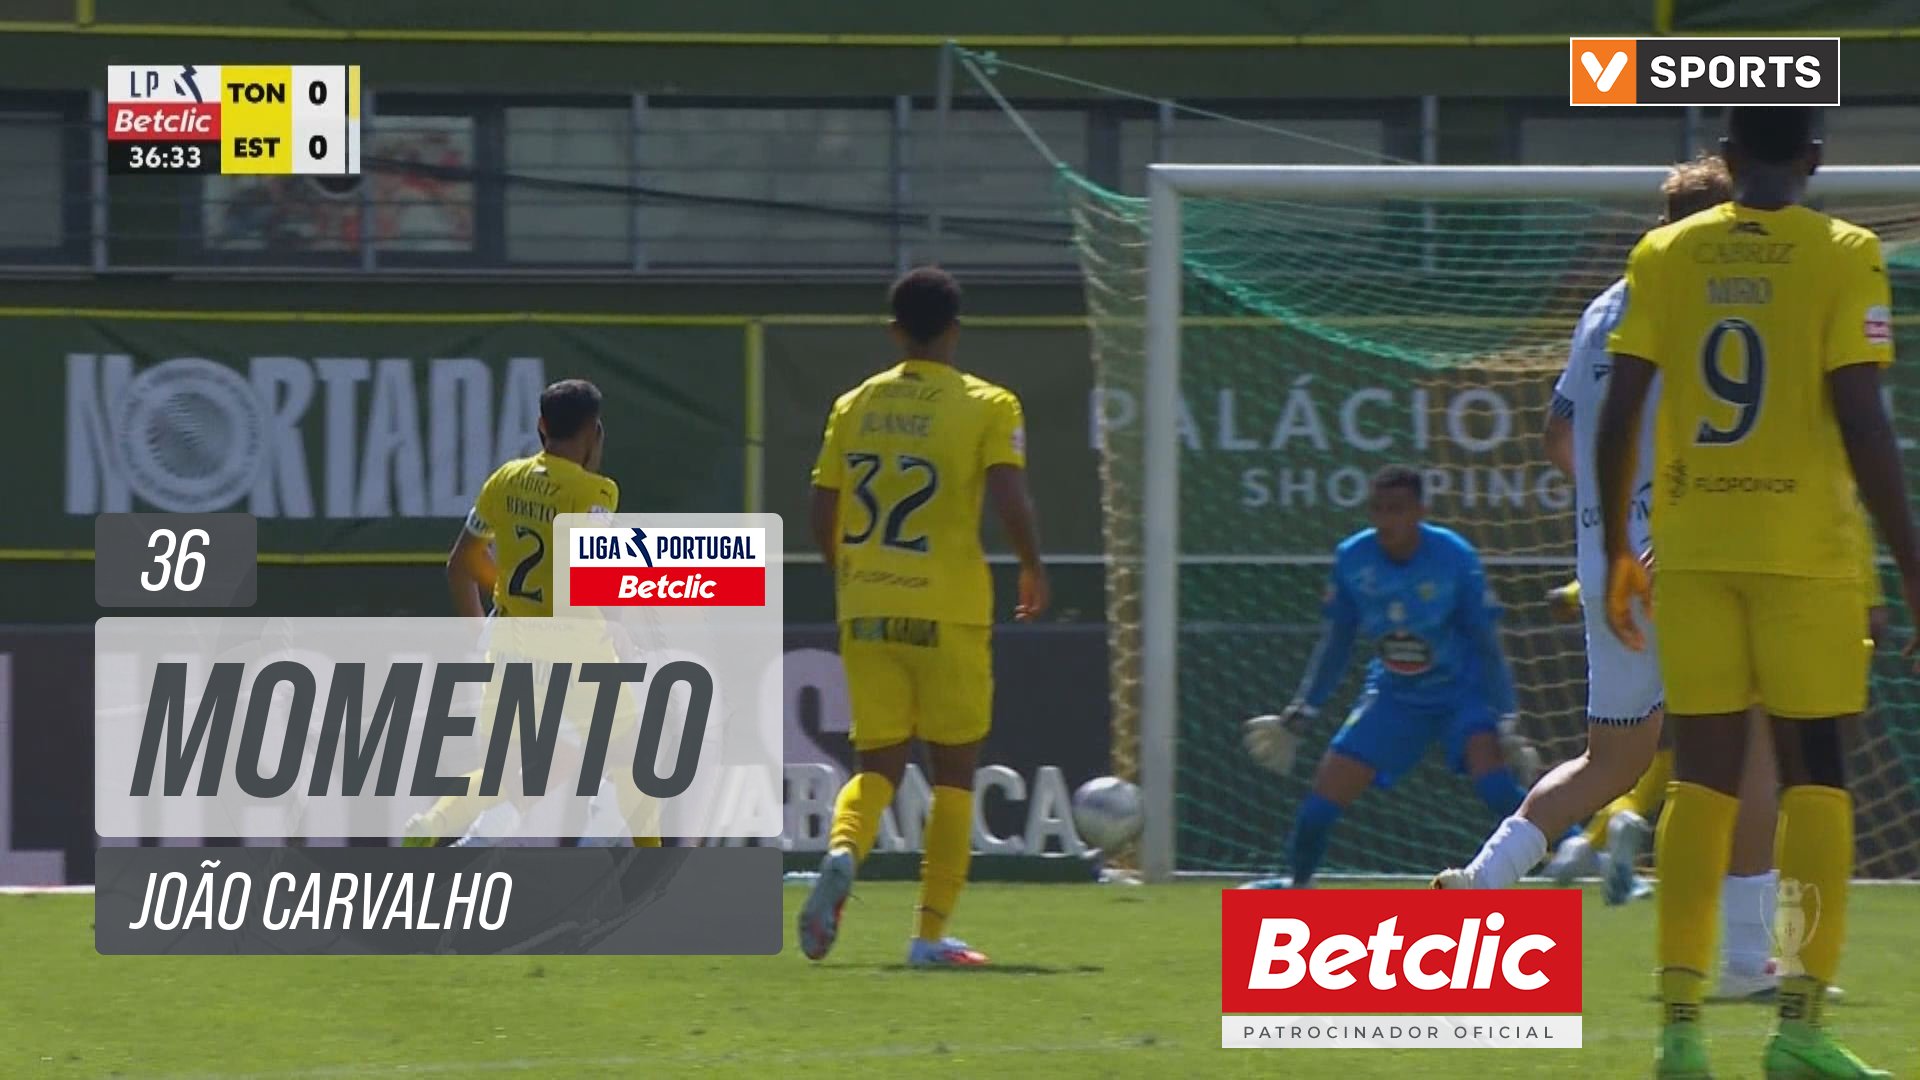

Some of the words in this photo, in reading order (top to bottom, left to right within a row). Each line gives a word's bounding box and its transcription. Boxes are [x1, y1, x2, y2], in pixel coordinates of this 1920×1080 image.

[1693, 318, 1766, 446] 9
[841, 452, 938, 553] 32
[1241, 466, 1573, 508] SHOPING
[508, 524, 545, 603] 2
